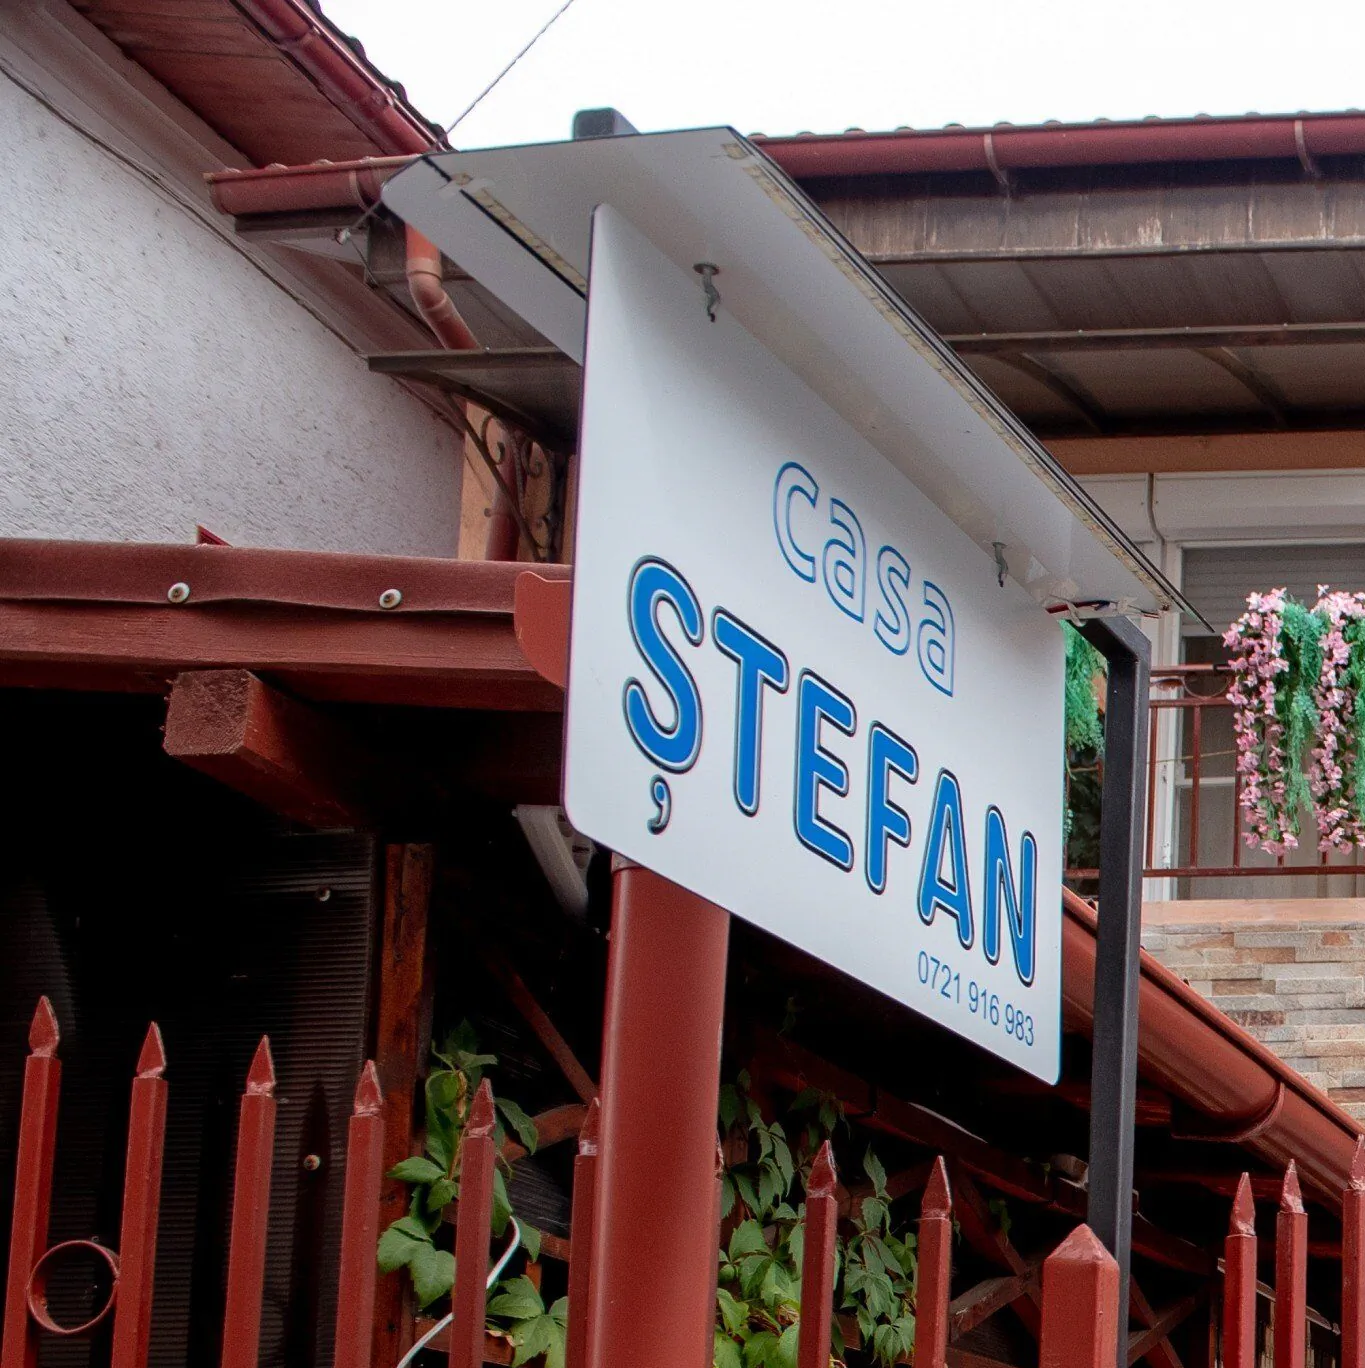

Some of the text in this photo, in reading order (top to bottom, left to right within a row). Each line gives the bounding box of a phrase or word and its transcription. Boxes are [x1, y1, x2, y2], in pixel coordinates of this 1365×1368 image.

[773, 461, 956, 697] casa
[622, 554, 1037, 988] ȘTEFAN
[918, 950, 1034, 1047] 0721 916 983
